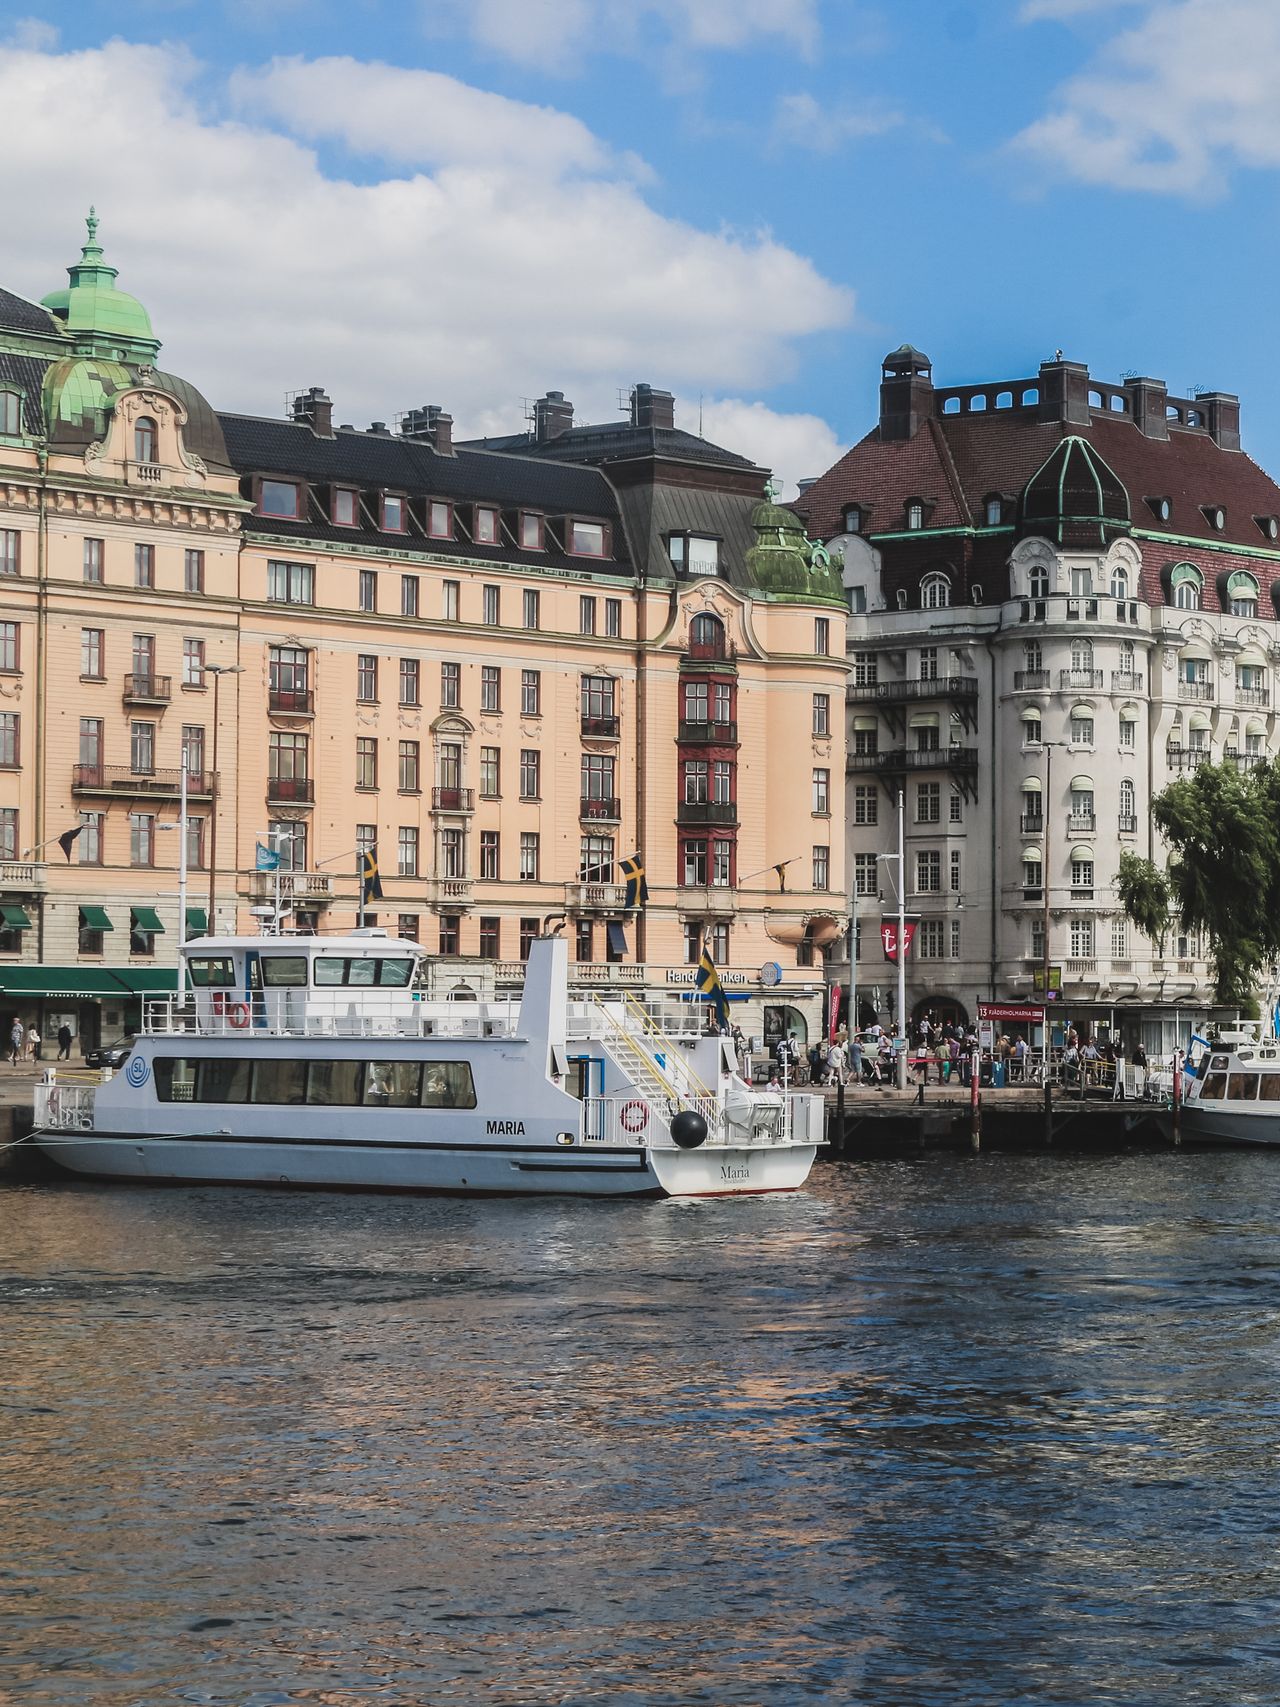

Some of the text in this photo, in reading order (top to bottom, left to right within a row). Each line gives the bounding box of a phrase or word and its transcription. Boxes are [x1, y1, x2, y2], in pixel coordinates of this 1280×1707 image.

[667, 970, 747, 982] Handanken
[979, 1008, 987, 1016] 13
[133, 1062, 142, 1072] SL
[486, 1120, 525, 1135] MARIA
[720, 1164, 750, 1179] Maria
